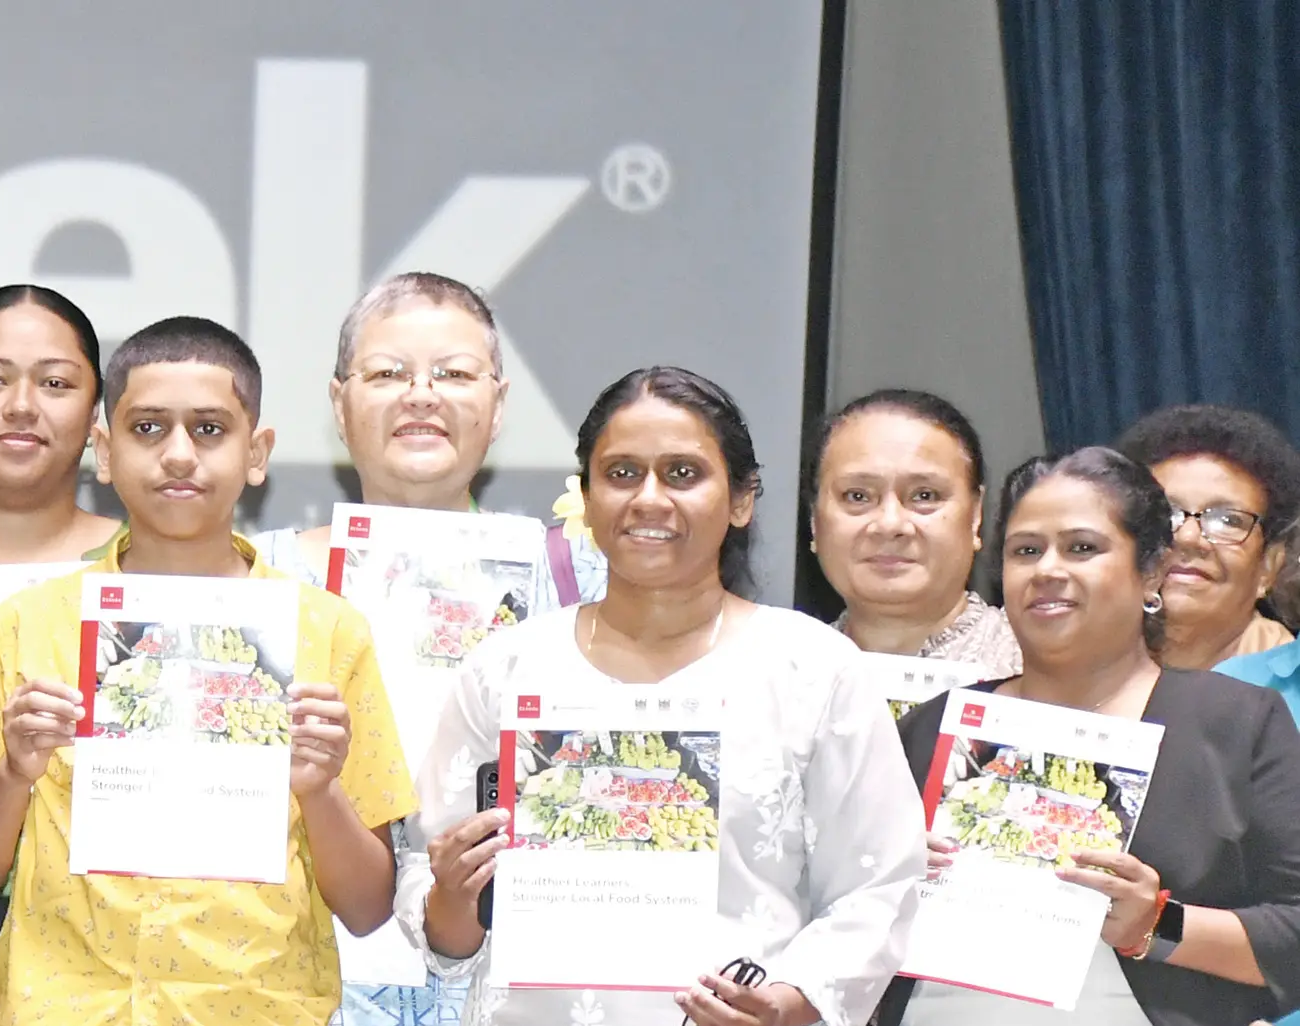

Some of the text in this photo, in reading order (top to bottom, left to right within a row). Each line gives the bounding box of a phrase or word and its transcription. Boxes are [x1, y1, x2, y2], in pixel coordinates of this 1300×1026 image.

[91, 764, 147, 776] Healthier
[91, 779, 143, 793] Stronger
[570, 893, 604, 903] Local
[608, 892, 640, 905] Food
[644, 893, 698, 905] Systems
